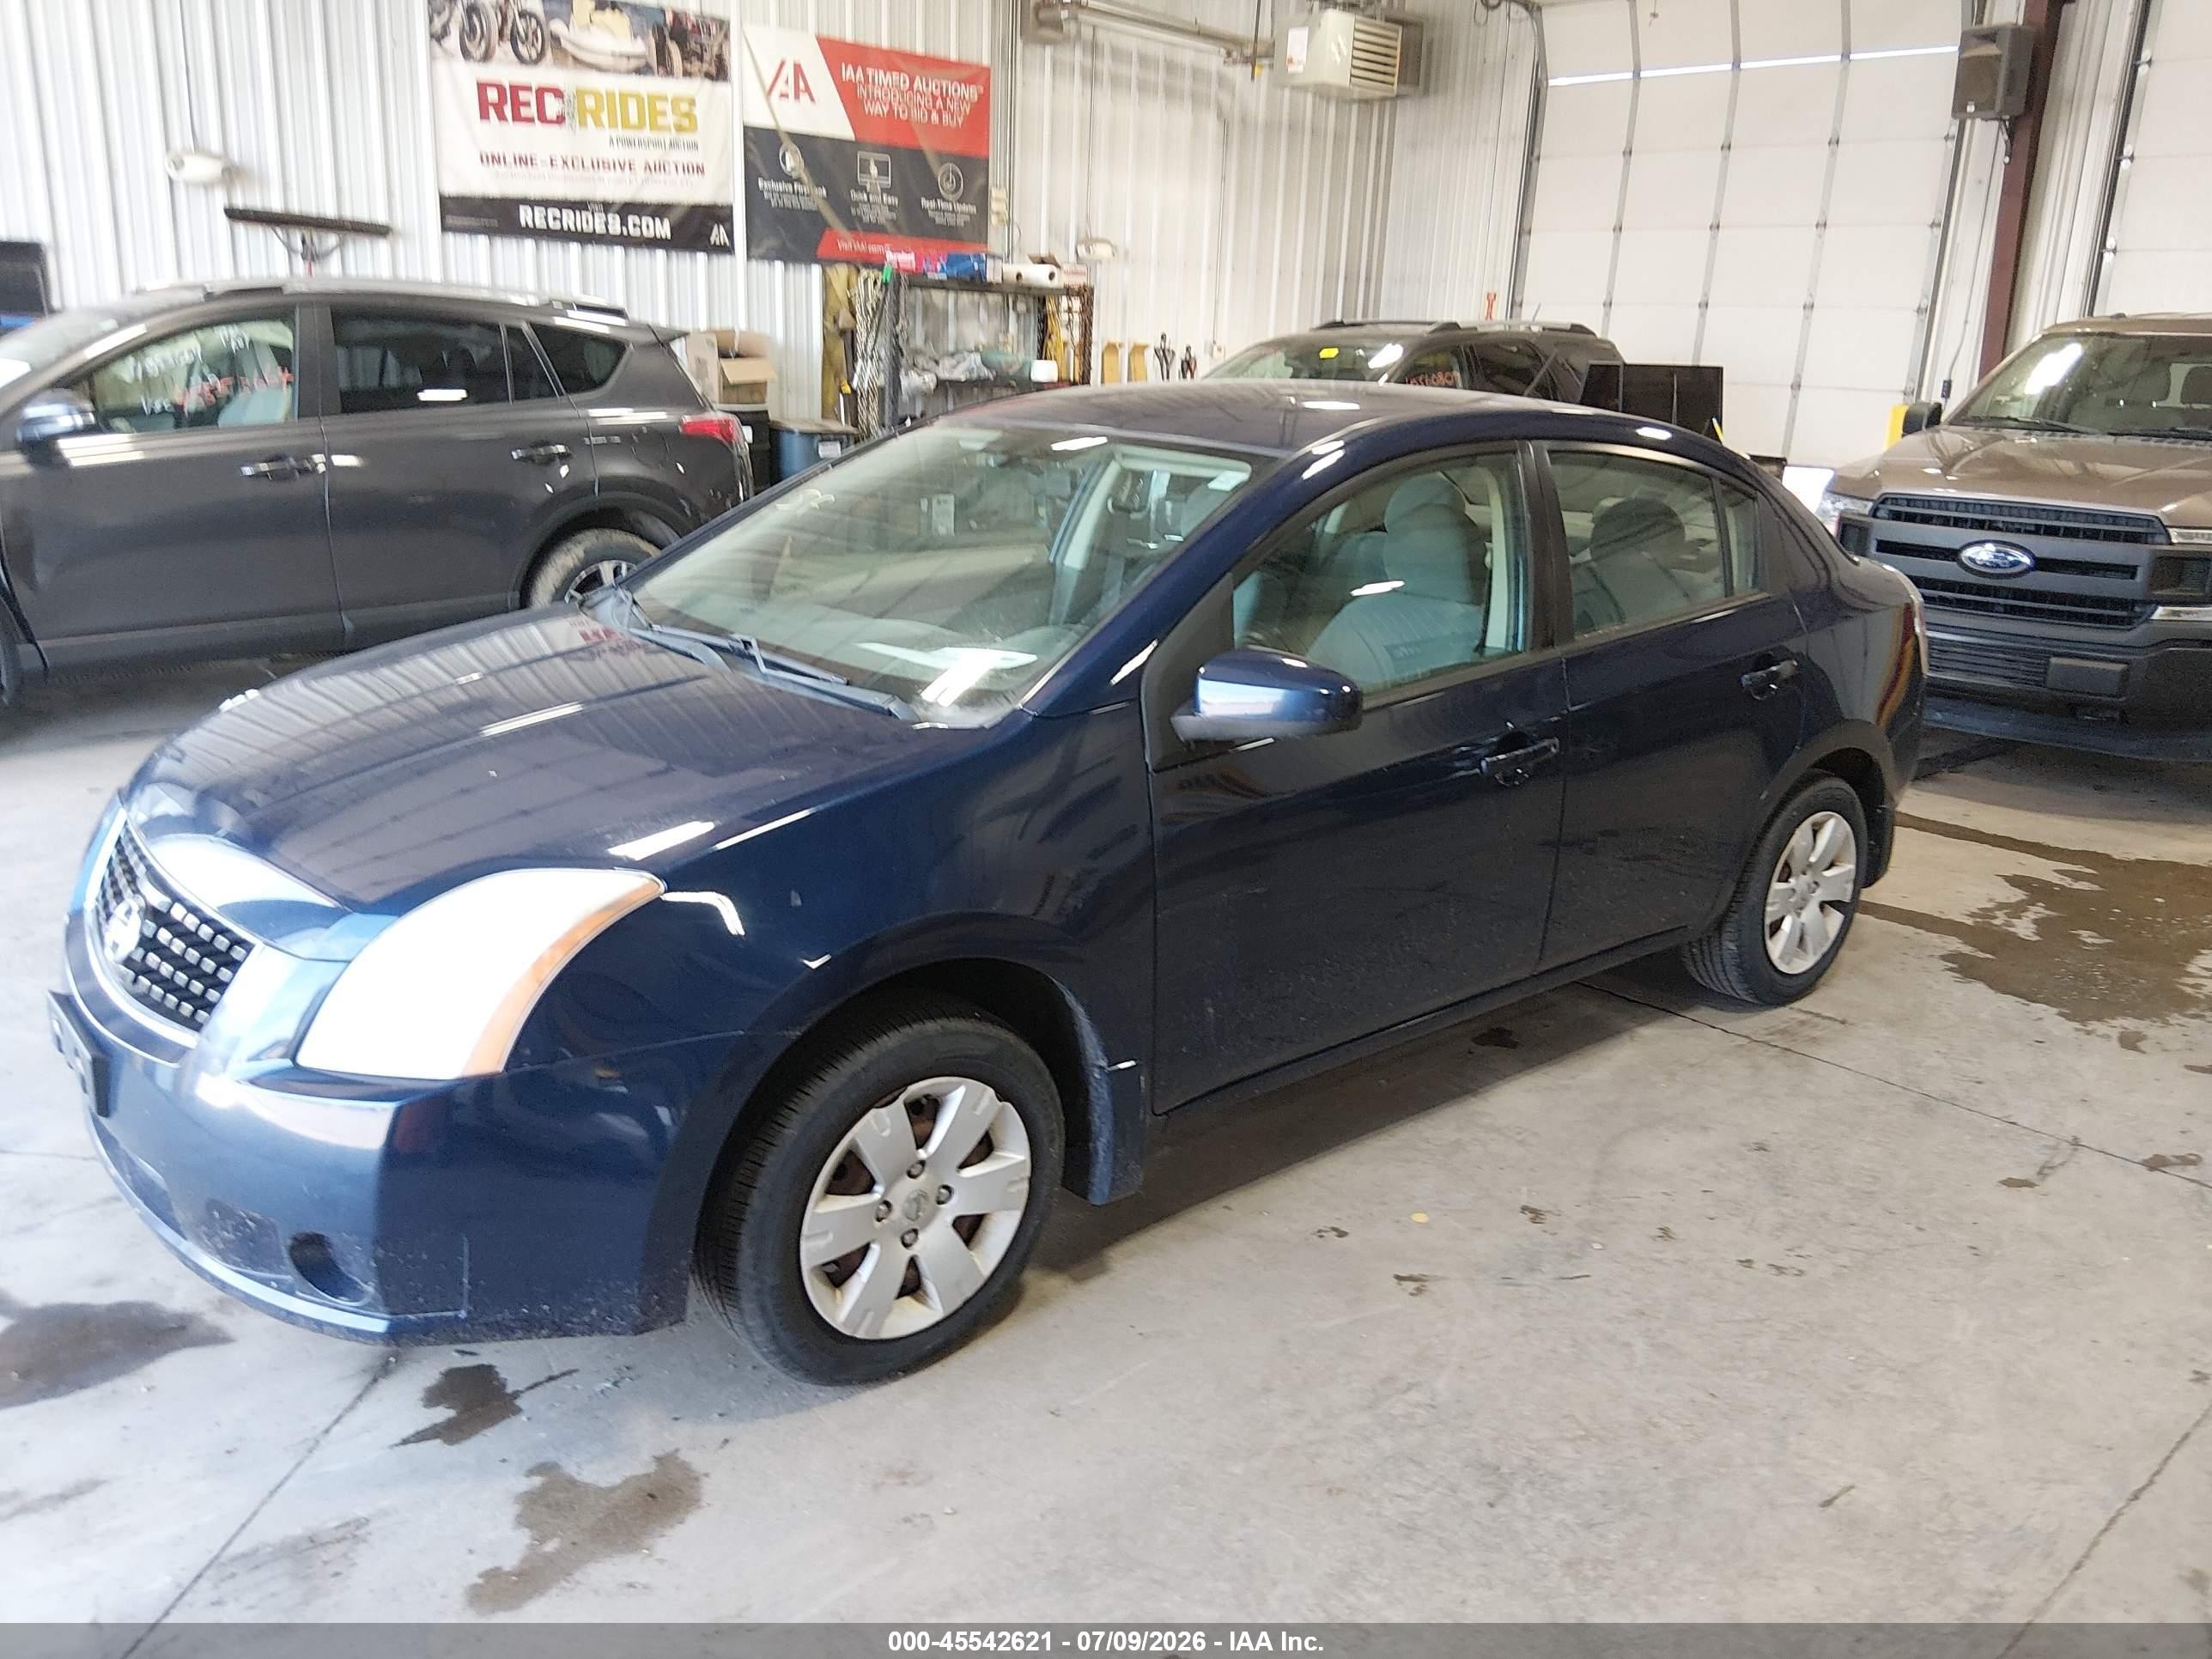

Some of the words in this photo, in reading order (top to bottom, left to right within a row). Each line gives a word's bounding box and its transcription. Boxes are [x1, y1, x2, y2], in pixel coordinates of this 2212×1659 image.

[842, 62, 864, 83] IAA
[866, 67, 909, 91] TIMED
[477, 82, 566, 125] REC
[575, 88, 698, 133] RIDES
[863, 99, 889, 118] WAY
[893, 103, 908, 120] TO
[644, 159, 705, 176] AUCTION
[519, 204, 672, 240] RECRIDES.COM
